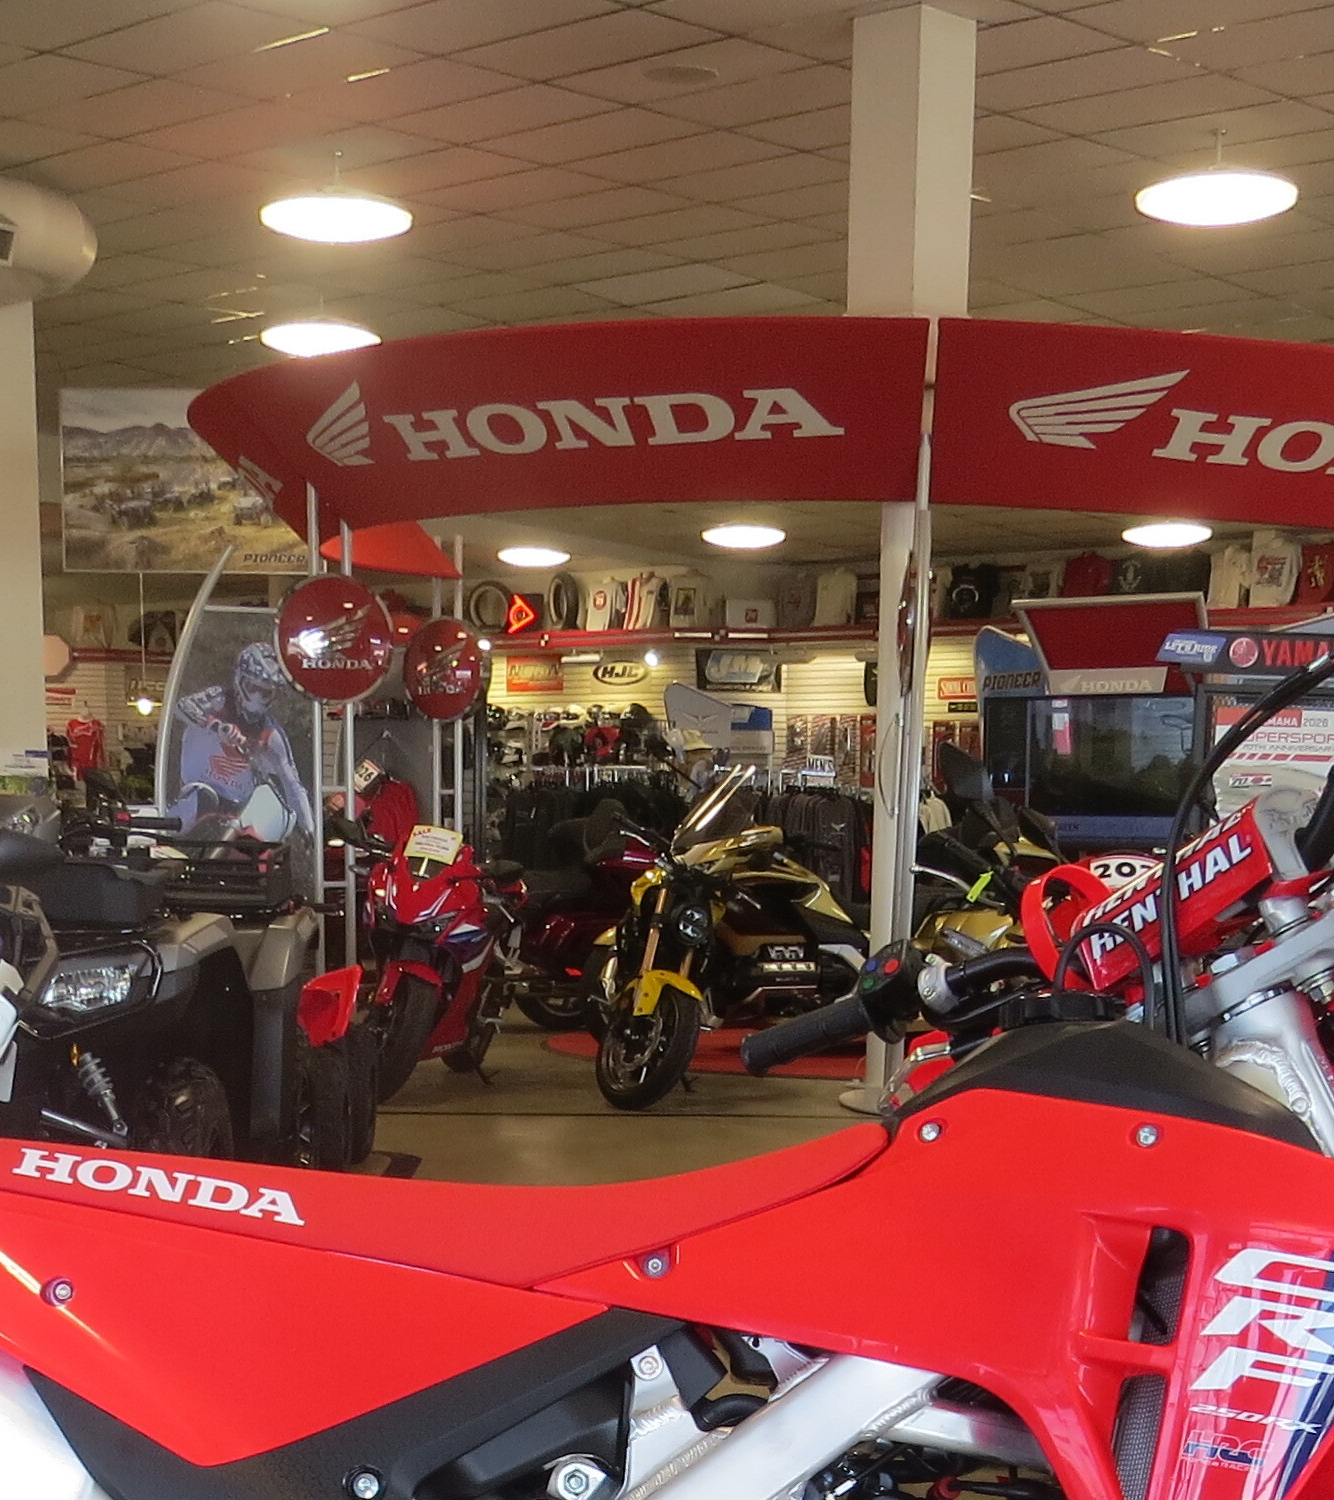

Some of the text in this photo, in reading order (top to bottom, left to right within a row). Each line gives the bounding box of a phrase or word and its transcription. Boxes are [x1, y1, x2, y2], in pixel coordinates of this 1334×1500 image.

[383, 387, 845, 461] HONDA
[300, 656, 373, 672] HONDA
[1079, 678, 1154, 693] HONDA
[1088, 832, 1253, 961] RENHAL
[12, 1147, 306, 1227] HONDA
[1188, 1403, 1322, 1434] 250RX
